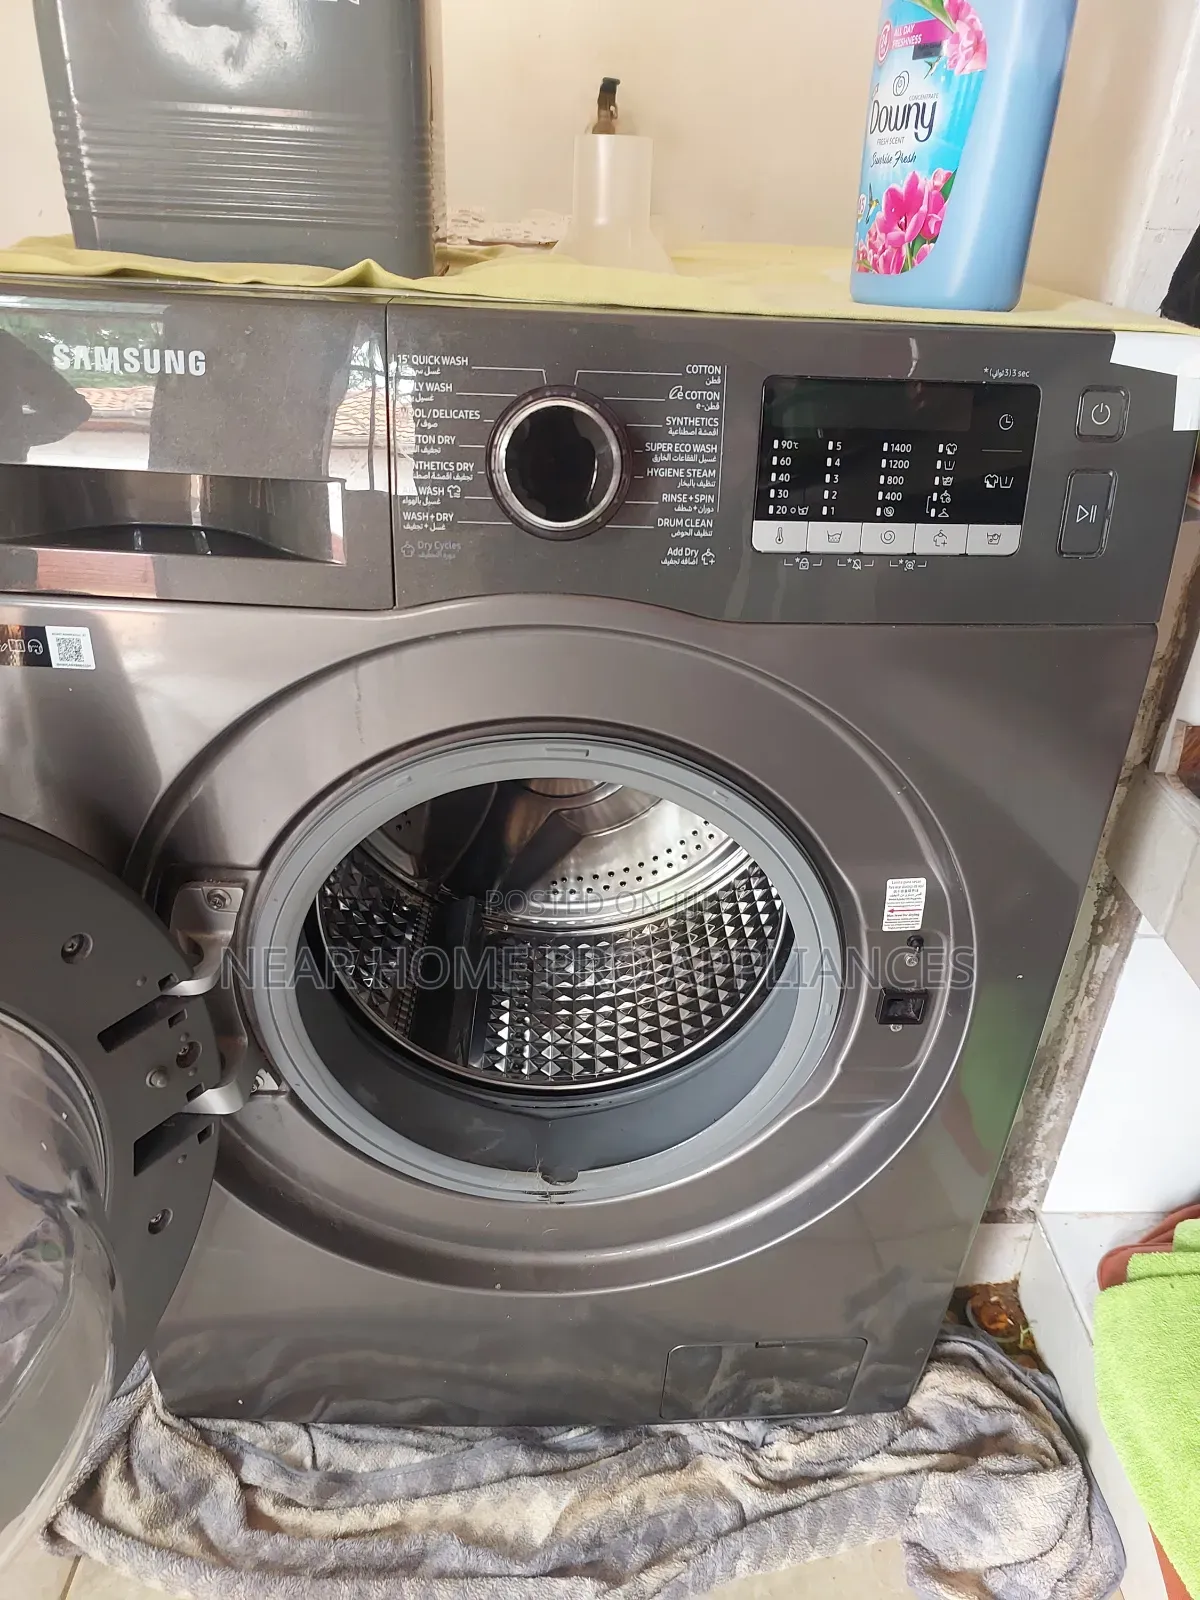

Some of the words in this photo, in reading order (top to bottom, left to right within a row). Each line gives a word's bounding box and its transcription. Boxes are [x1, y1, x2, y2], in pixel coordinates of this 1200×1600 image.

[903, 23, 916, 35] DAY
[892, 34, 922, 48] FRESHNESS
[869, 99, 938, 143] Downy
[889, 136, 905, 145] SCENT
[53, 343, 206, 377] SAMSUNG
[412, 355, 440, 365] QUICK
[441, 355, 469, 366] WASH
[686, 364, 722, 375] COTTON
[1017, 370, 1030, 378] sec
[705, 375, 721, 386] قطن
[426, 382, 453, 393] WASH
[685, 390, 720, 401] COTTON
[666, 416, 719, 427] SYNTHETICS
[437, 435, 456, 445] DRY
[645, 442, 673, 452] SUPER
[674, 443, 691, 453] ECO
[692, 443, 718, 453] WASH
[836, 441, 842, 451] 5
[890, 443, 912, 453] 1400
[779, 456, 792, 466] 60
[834, 457, 840, 467] 4
[888, 459, 910, 469] 1200
[456, 462, 475, 472] DRY
[646, 467, 685, 477] HYGIENE
[686, 468, 716, 478] STEAM
[778, 473, 791, 482] 40
[833, 474, 839, 483] 3
[886, 475, 904, 485] 800
[418, 485, 445, 496] WASH
[777, 489, 789, 498] 30
[831, 490, 838, 500] 2
[884, 491, 902, 501] 400
[775, 505, 788, 514] 20
[830, 506, 835, 515] 1
[657, 517, 683, 527] DRUM
[684, 518, 713, 528] CLEAN
[417, 540, 433, 551] Dry
[434, 540, 461, 552] Cycles
[667, 547, 684, 556] Add
[684, 547, 699, 558] Dry
